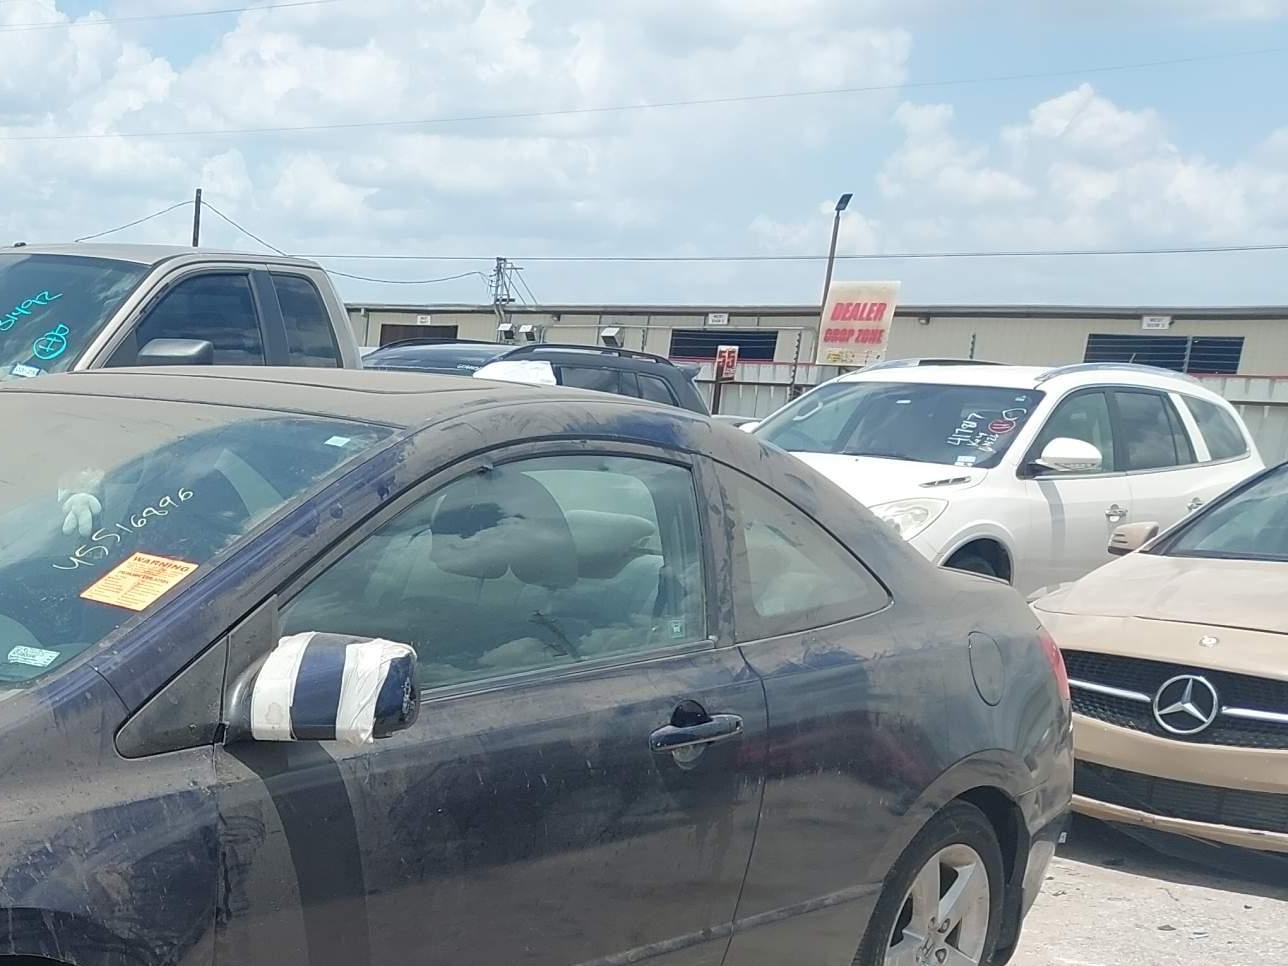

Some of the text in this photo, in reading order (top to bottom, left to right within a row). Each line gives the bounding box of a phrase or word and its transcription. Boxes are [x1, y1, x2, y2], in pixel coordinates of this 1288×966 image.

[830, 302, 887, 321] DEALER
[854, 328, 885, 344] ZONE
[52, 487, 194, 570] 45516896
[133, 555, 190, 572] WARNING
